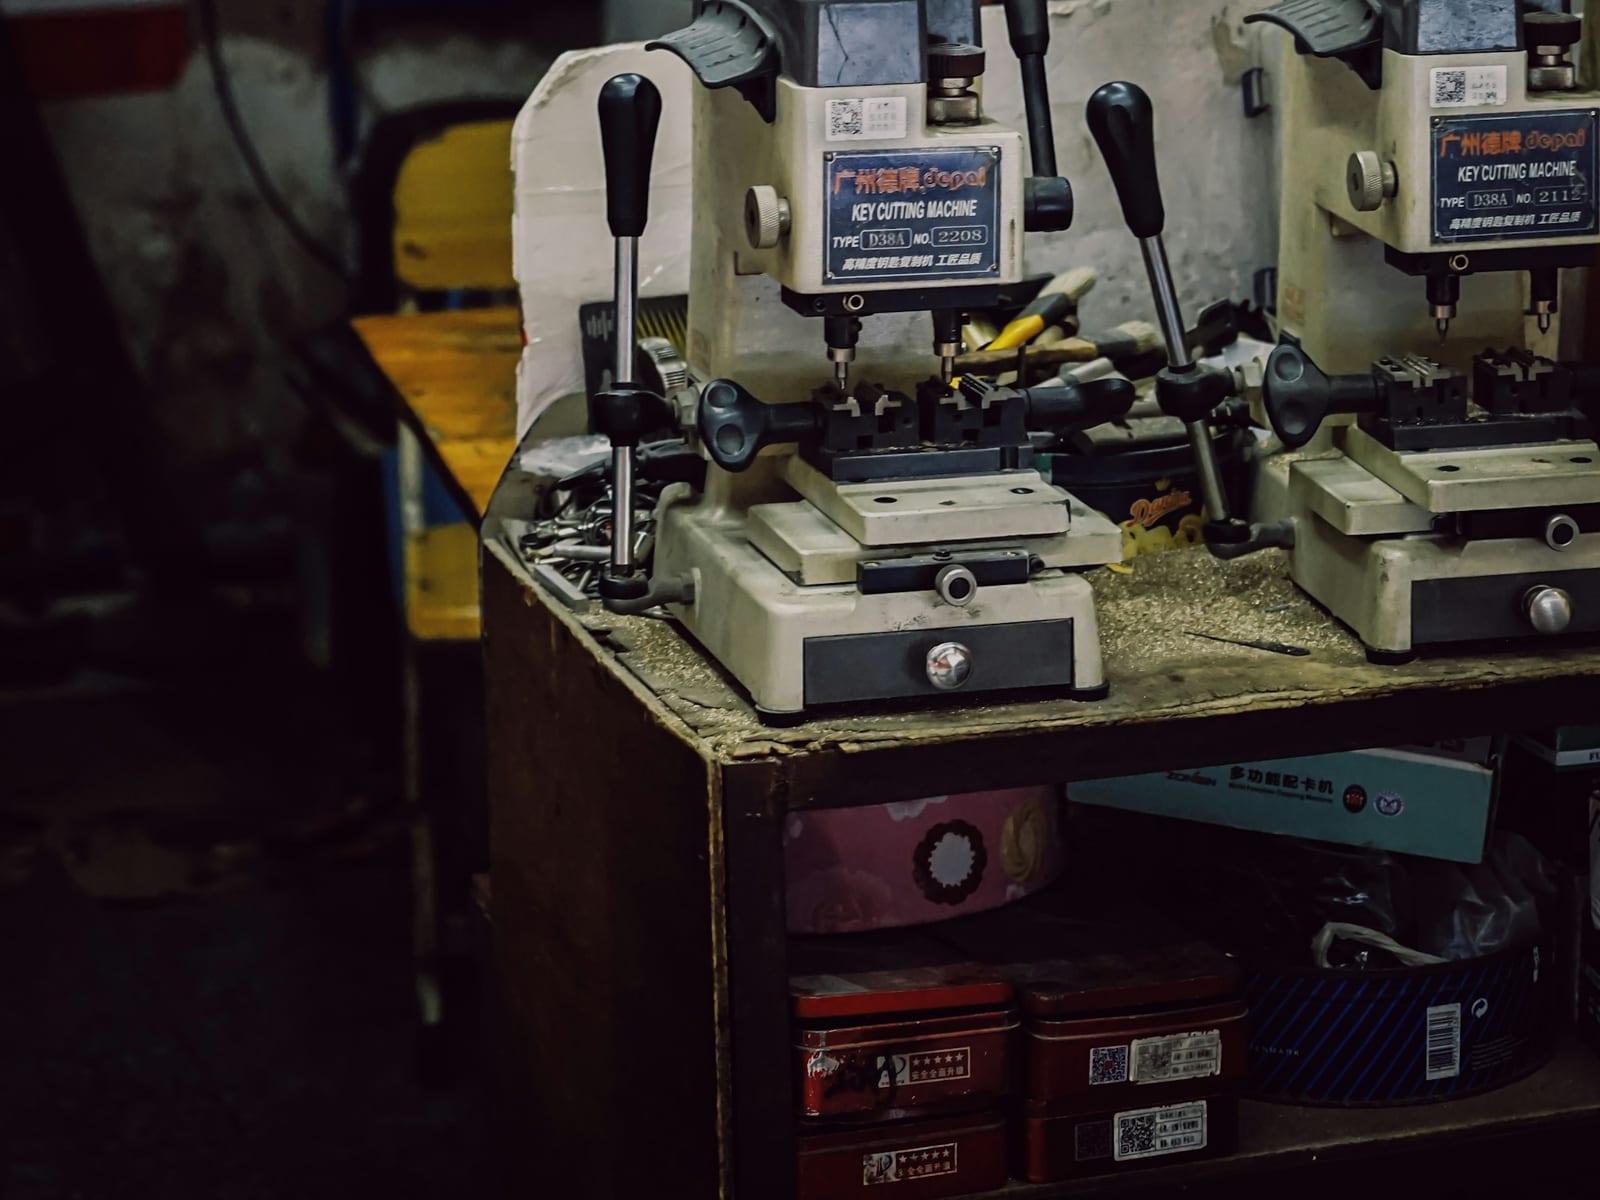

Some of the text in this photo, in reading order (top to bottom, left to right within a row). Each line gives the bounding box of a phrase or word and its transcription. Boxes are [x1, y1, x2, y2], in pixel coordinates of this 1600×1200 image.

[1458, 160, 1577, 182] KEY CUTTING MACHINE
[1440, 197, 1465, 208] TYPE
[1473, 193, 1508, 207] D38A
[852, 199, 977, 222] KEY CUTTING MACHINE
[1537, 210, 1582, 225] 工匠品质
[833, 235, 860, 248] TYPE
[868, 233, 905, 248] D38A
[938, 229, 982, 243] 2208
[935, 252, 982, 267] 工匠品质
[1229, 766, 1333, 794] 多功能配卡机
